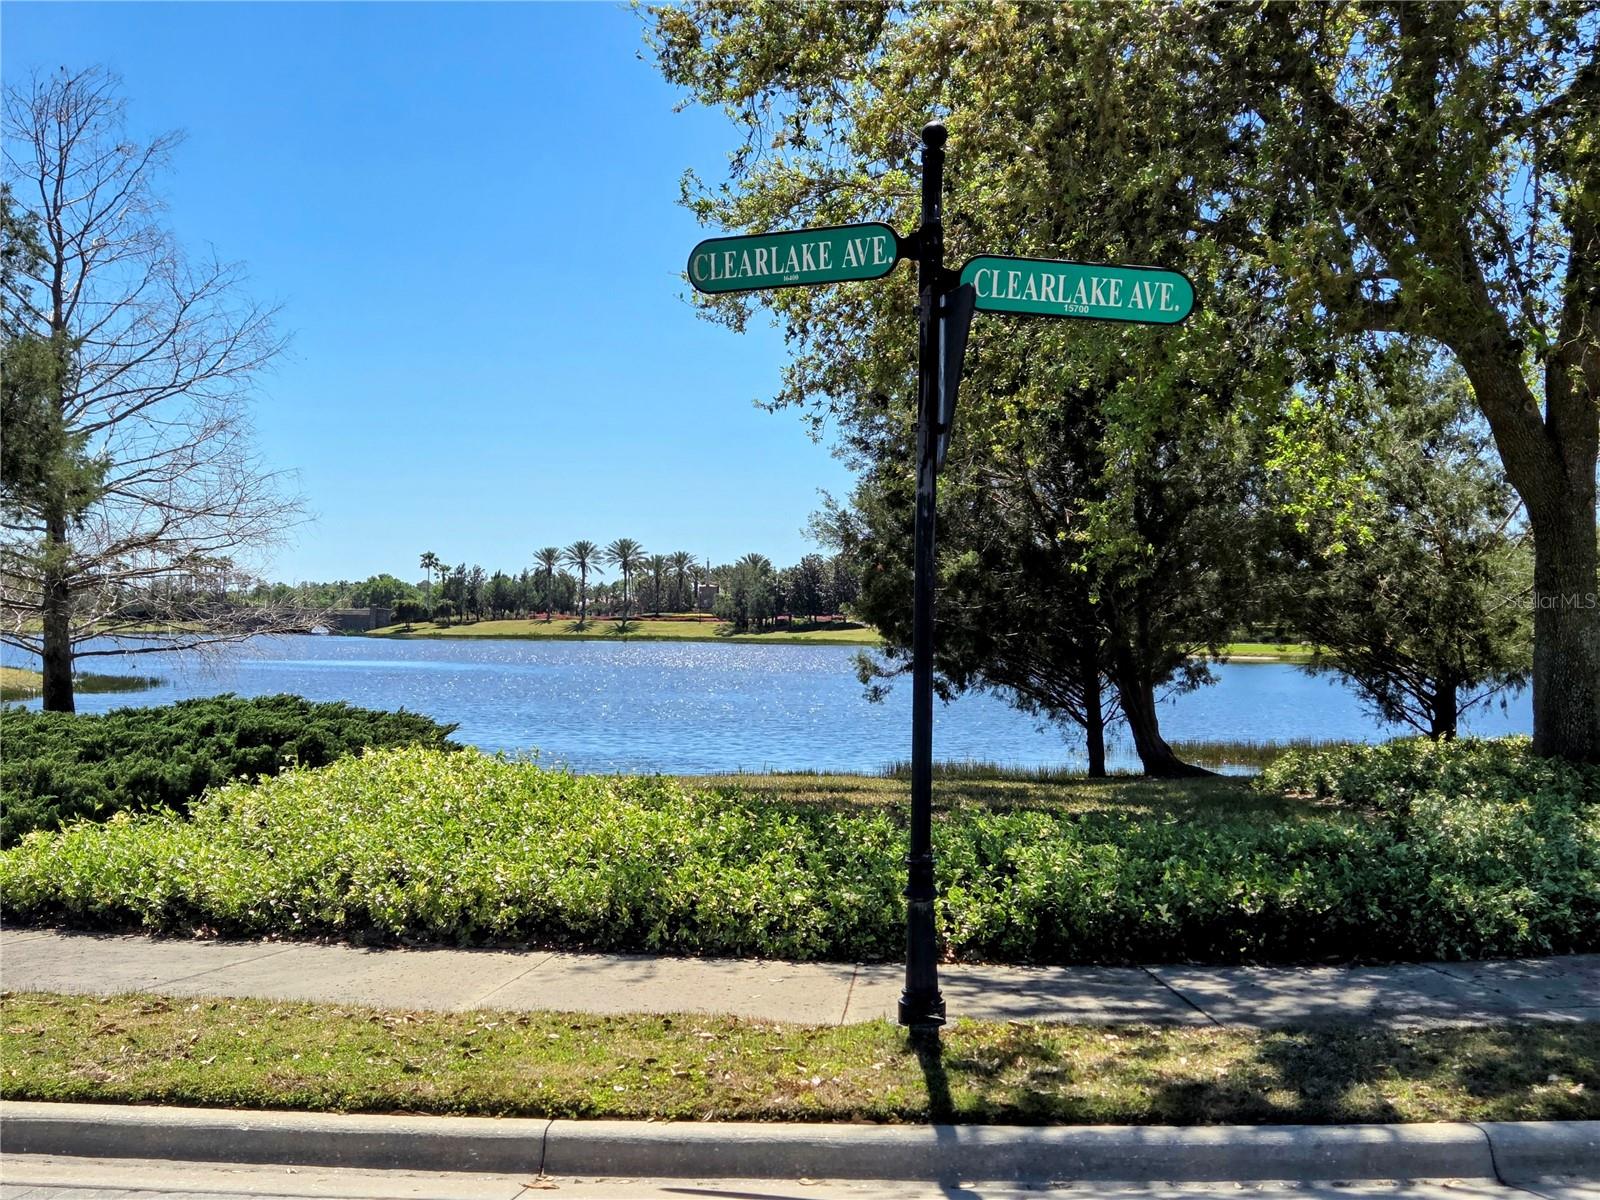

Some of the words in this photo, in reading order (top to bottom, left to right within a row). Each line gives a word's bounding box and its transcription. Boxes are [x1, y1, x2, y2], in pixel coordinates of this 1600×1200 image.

[693, 241, 833, 281] CLEARLAKE
[842, 235, 894, 268] AVE.
[973, 268, 1123, 307] CLEARLAKE
[1128, 280, 1180, 312] AVE.
[1064, 303, 1089, 314] 15700
